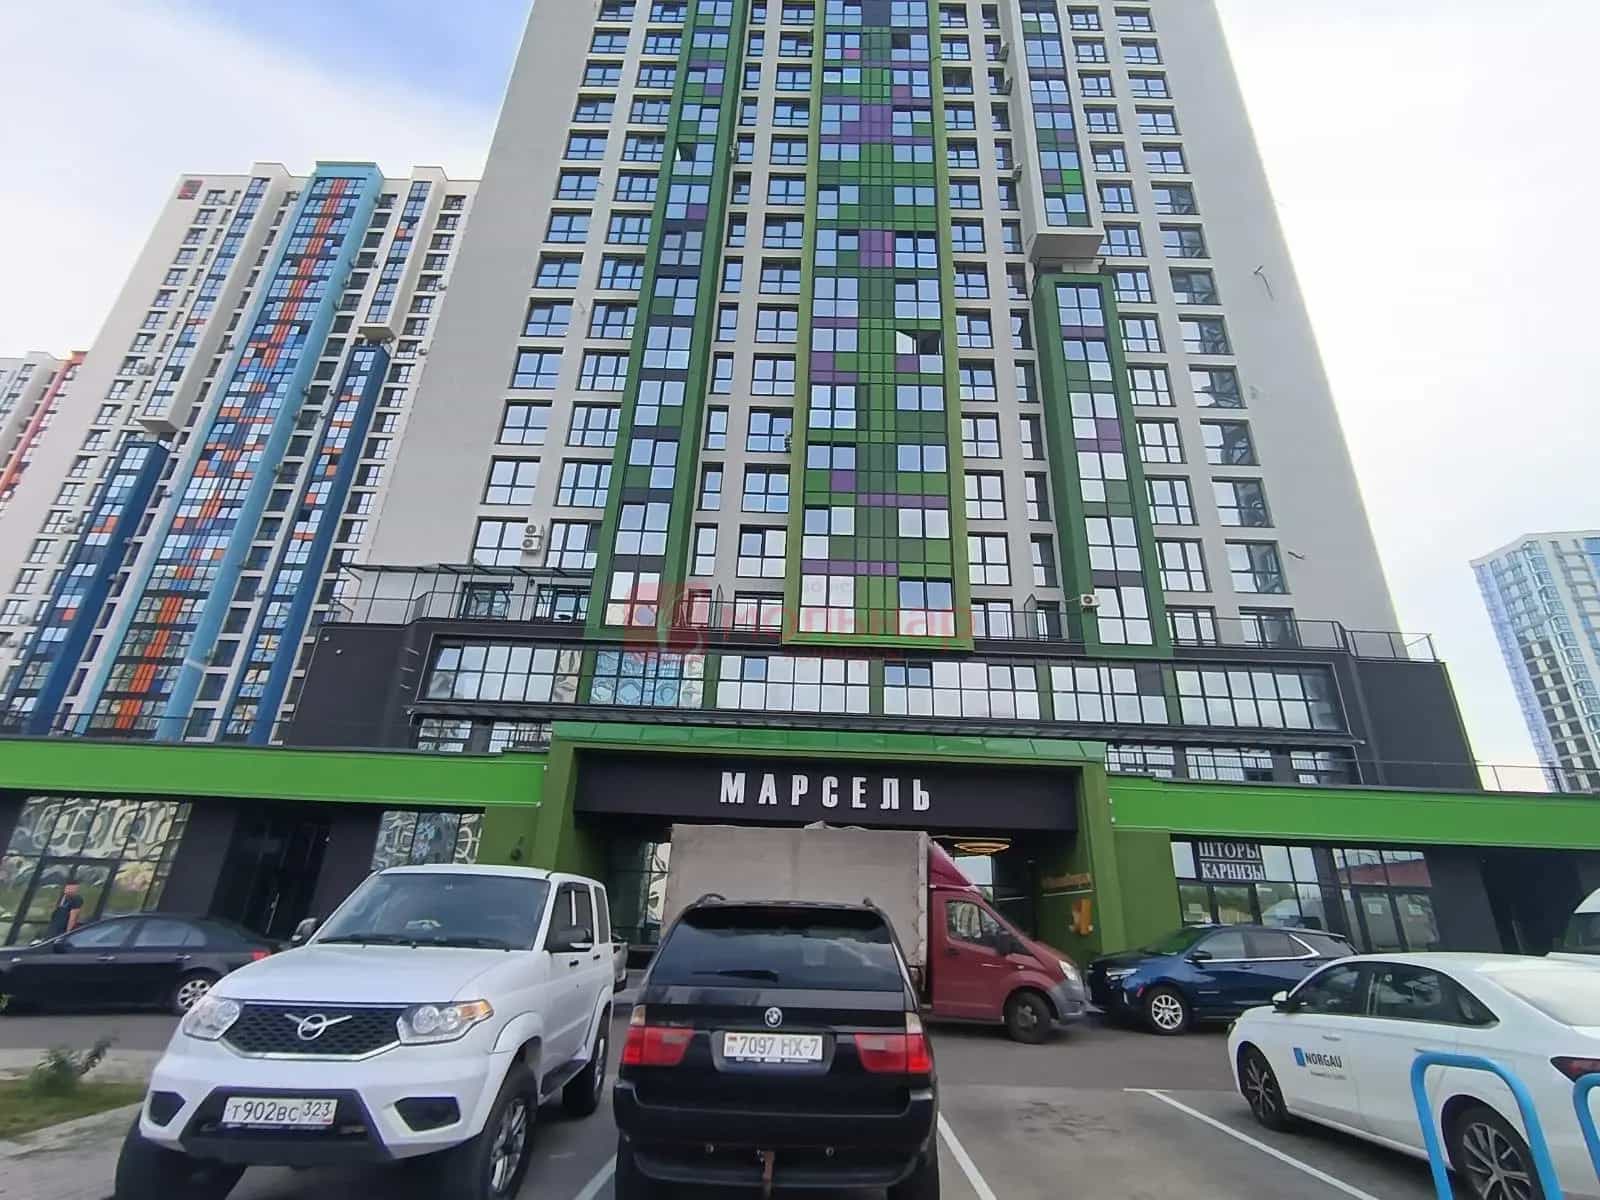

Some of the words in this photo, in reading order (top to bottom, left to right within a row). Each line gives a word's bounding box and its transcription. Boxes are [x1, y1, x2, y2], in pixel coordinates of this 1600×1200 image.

[720, 772, 930, 810] МАРСЕЛЬ
[1199, 842, 1261, 859] ШТОРЫ
[1201, 863, 1265, 880] КАРНИЗЫ
[739, 1036, 777, 1055] 7097
[1305, 1052, 1343, 1068] NORGAU
[303, 1101, 332, 1117] 323
